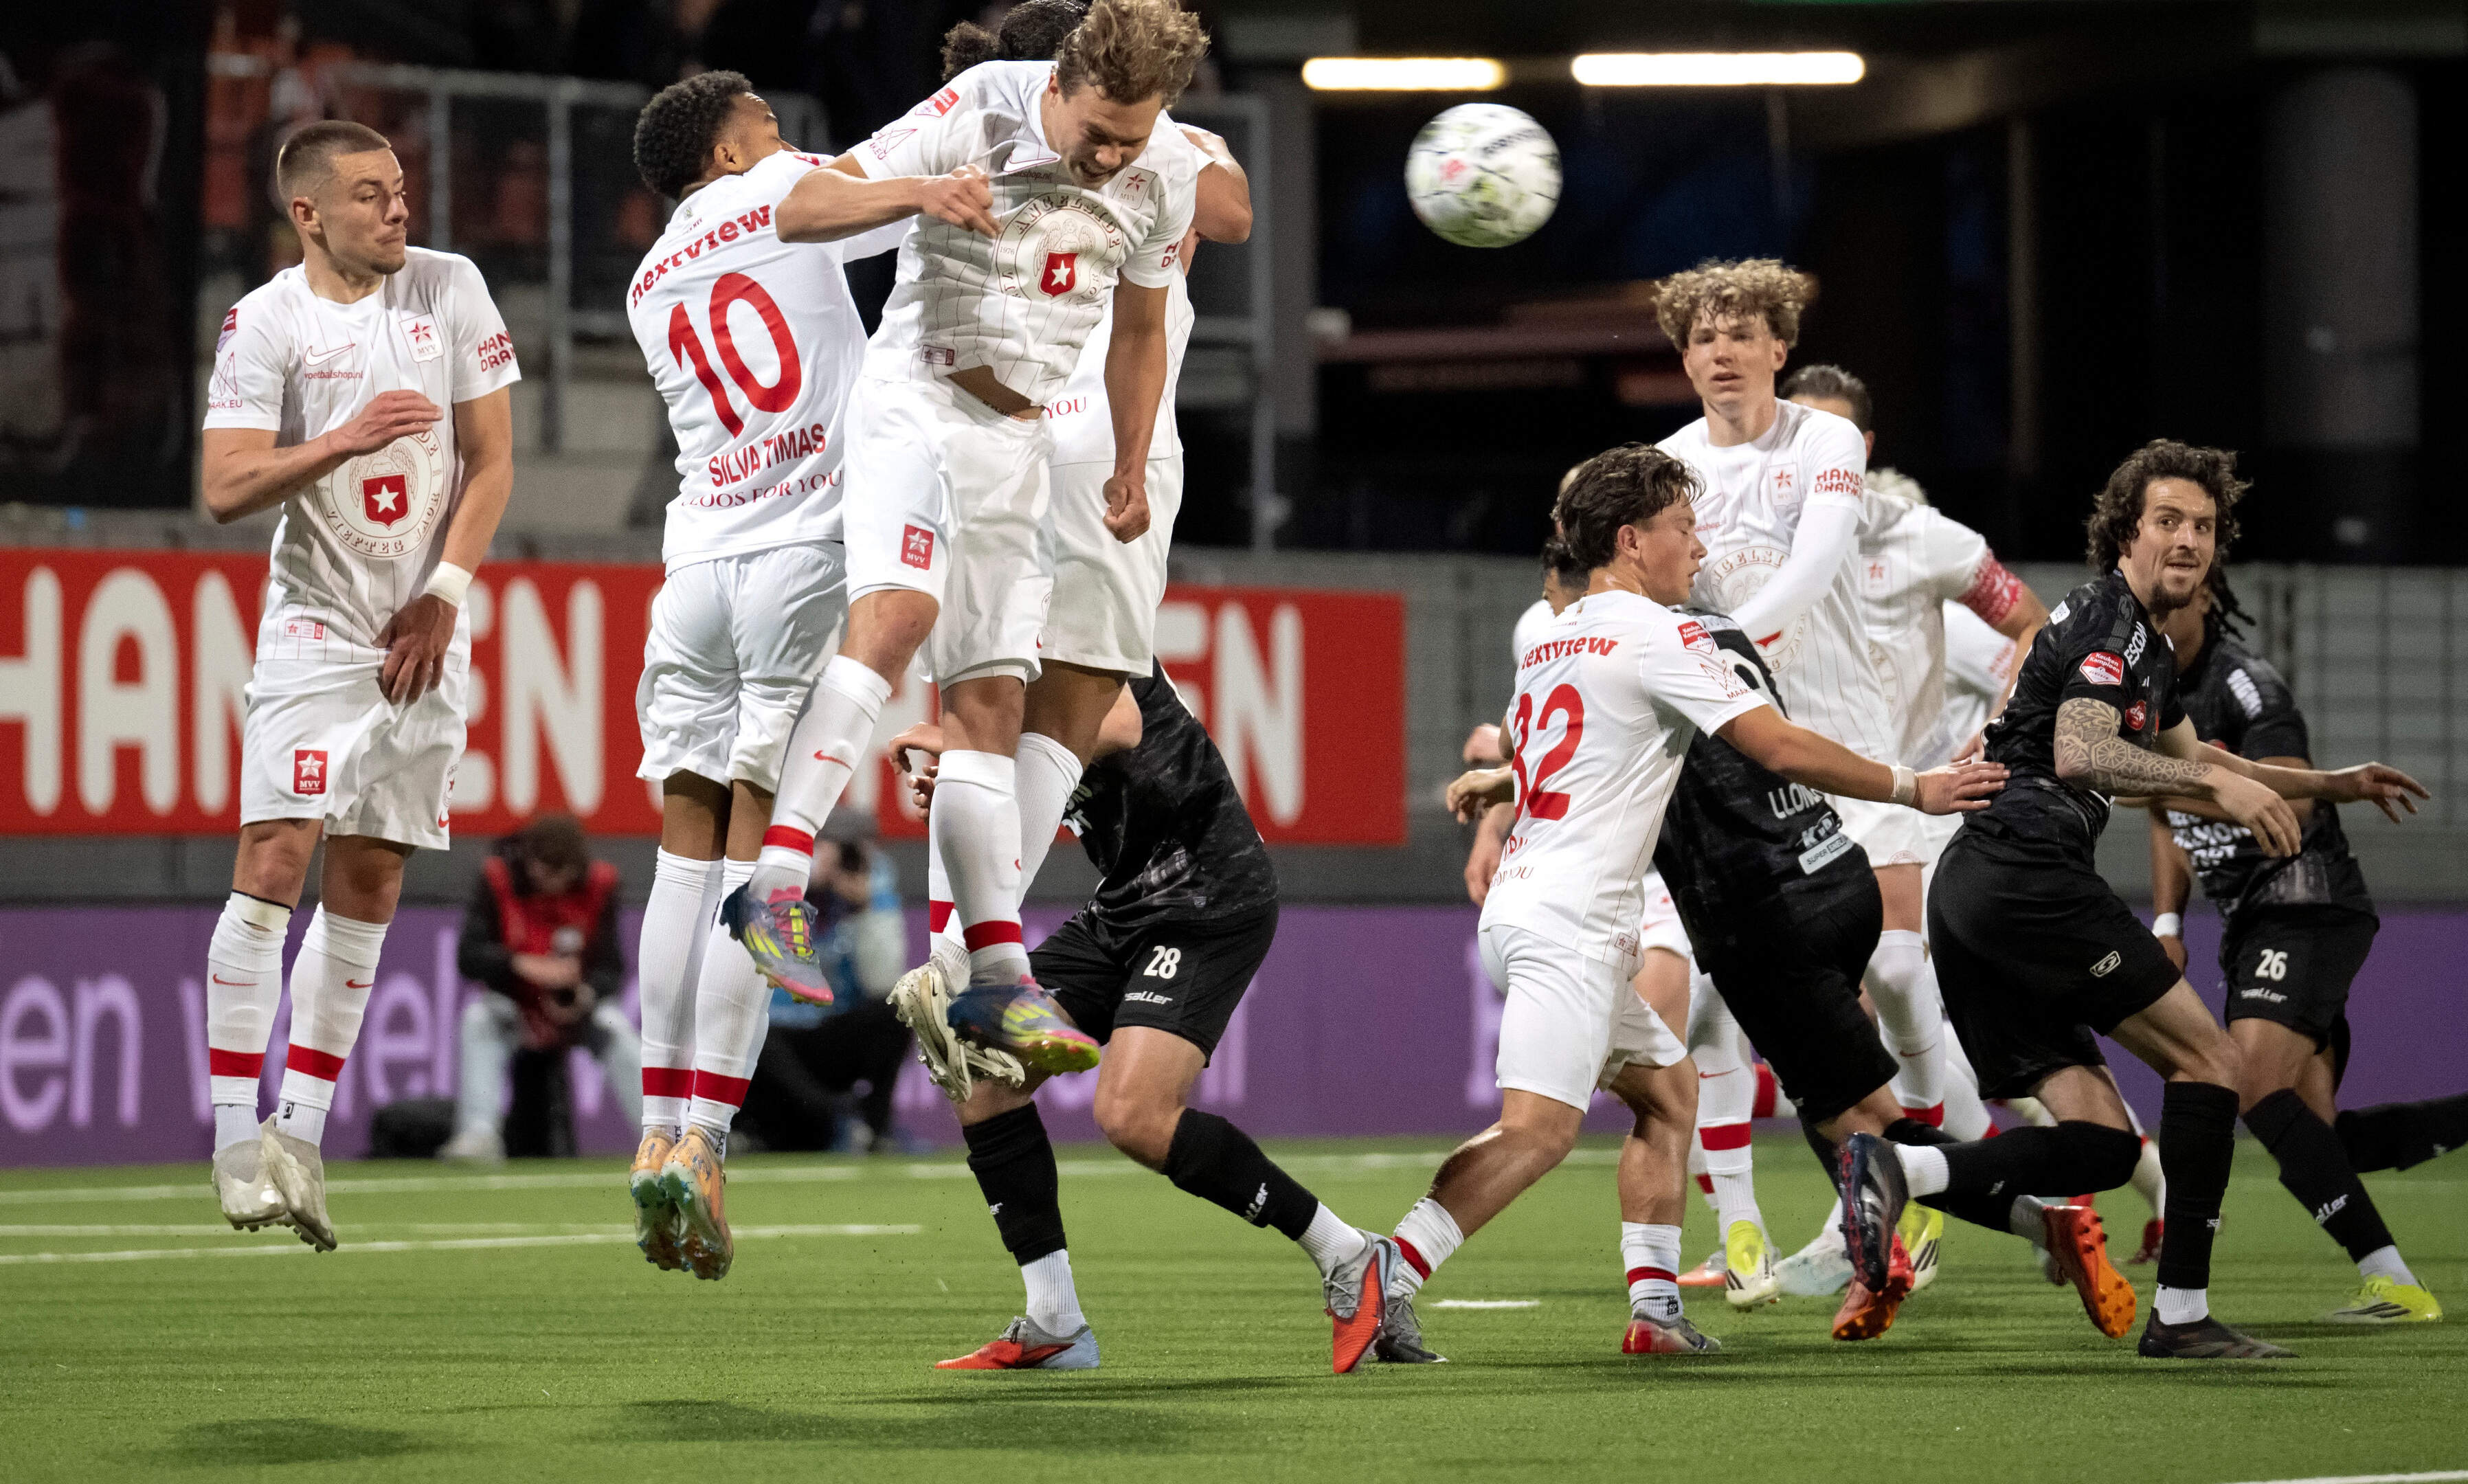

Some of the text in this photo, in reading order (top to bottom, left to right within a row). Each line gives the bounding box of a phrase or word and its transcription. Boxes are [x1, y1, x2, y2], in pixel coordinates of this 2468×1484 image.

[1013, 194, 1121, 249] ANGELSIDE
[632, 205, 771, 309] nextview
[669, 272, 802, 440] 10
[304, 370, 363, 380] voetbalshop.nl
[1044, 396, 1087, 419] YOU
[708, 423, 825, 488] SILVA TIMAS
[752, 482, 791, 503] FOR
[798, 470, 842, 493] YOU
[328, 508, 404, 554] VIEFTEG
[906, 552, 926, 563] MVV
[2089, 657, 2120, 673] Kampioen
[2096, 653, 2119, 667] Keuken
[1512, 683, 1584, 822] 32
[300, 780, 320, 788] MVV
[1806, 848, 1828, 865] SUPER
[1143, 945, 1182, 980] 28
[2254, 948, 2288, 982] 26
[1124, 991, 1174, 1004] saller
[2241, 987, 2287, 1003] saller
